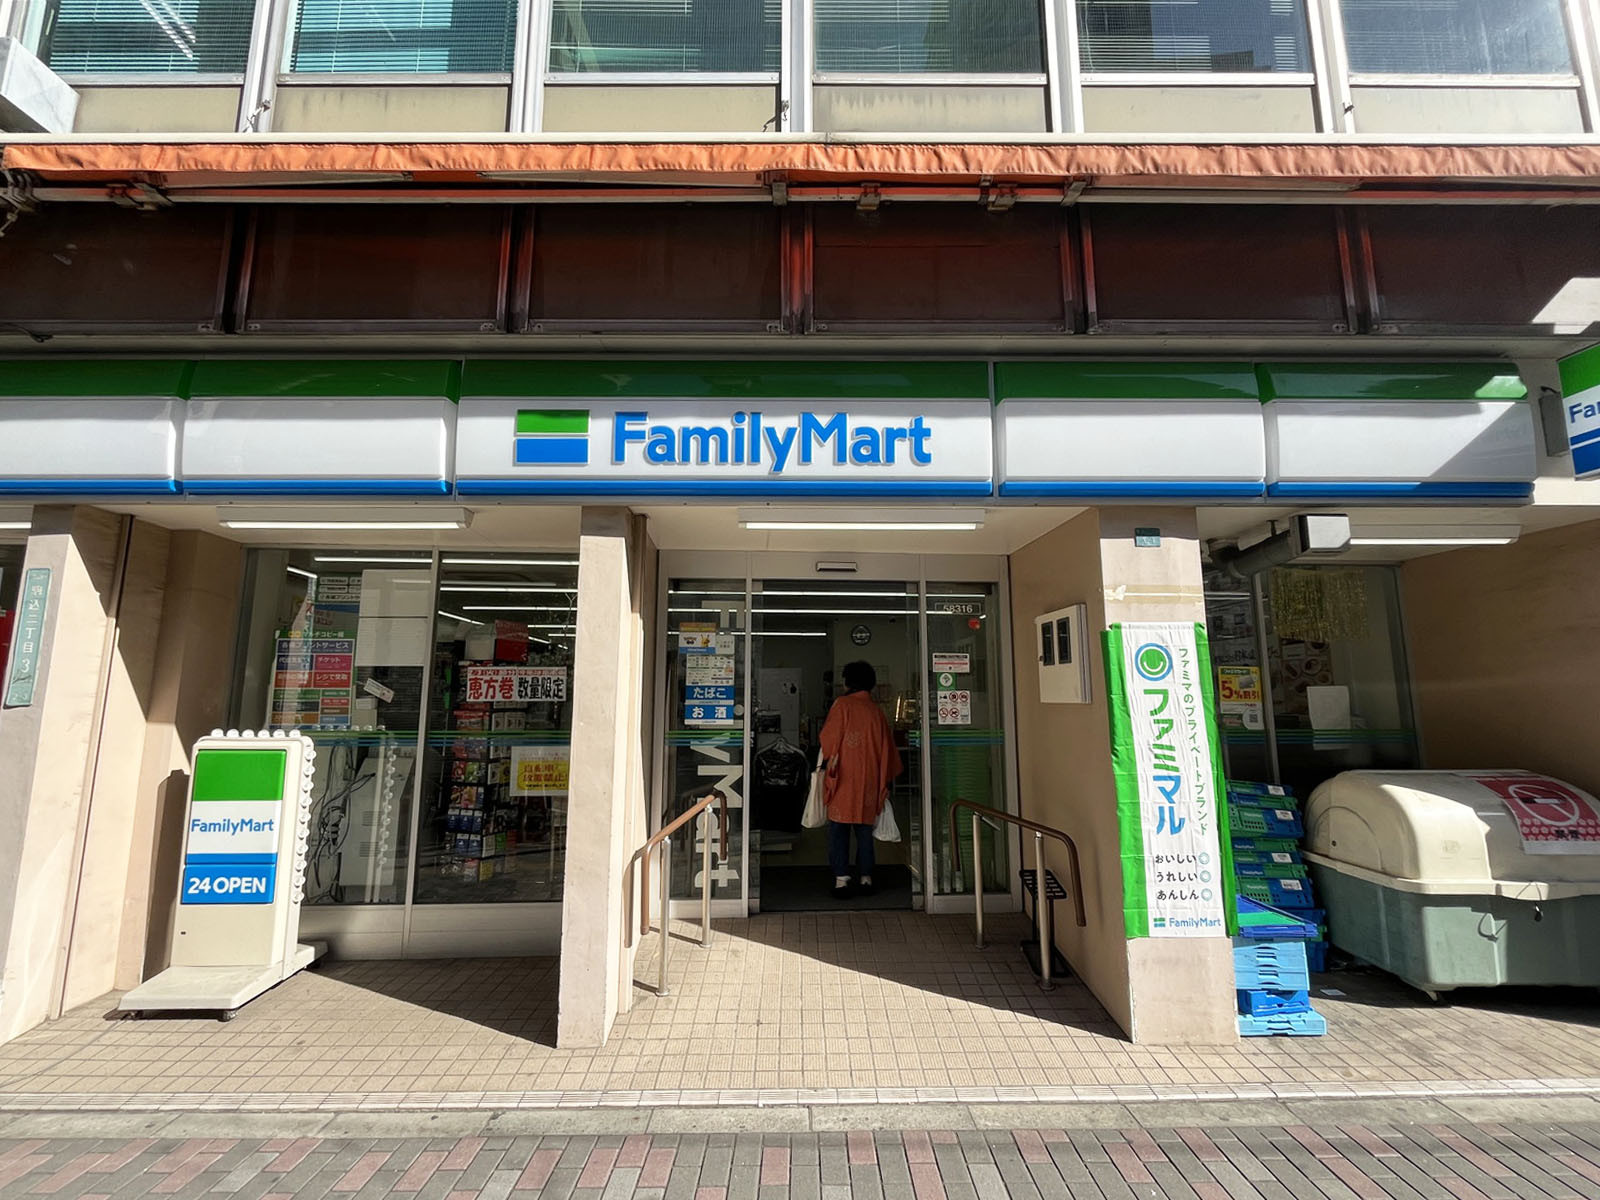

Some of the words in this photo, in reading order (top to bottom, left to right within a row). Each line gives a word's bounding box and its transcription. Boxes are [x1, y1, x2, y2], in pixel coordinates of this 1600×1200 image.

[1568, 399, 1600, 424] Fa
[613, 411, 932, 474] FamilyMart
[943, 603, 973, 614] 58316
[468, 677, 514, 700] 恵方巻
[517, 676, 565, 700] 数量限定
[692, 687, 727, 699] たばこ
[1178, 648, 1208, 836] ファミマのプライベートブランド
[1143, 688, 1186, 836] ファミマル
[190, 818, 275, 836] FamilyMart
[1155, 853, 1197, 864] おいしい
[213, 876, 267, 893] OPEN
[1156, 871, 1198, 883] うれしい
[1157, 889, 1200, 901] あんしん
[1168, 917, 1222, 928] FamilyMart
